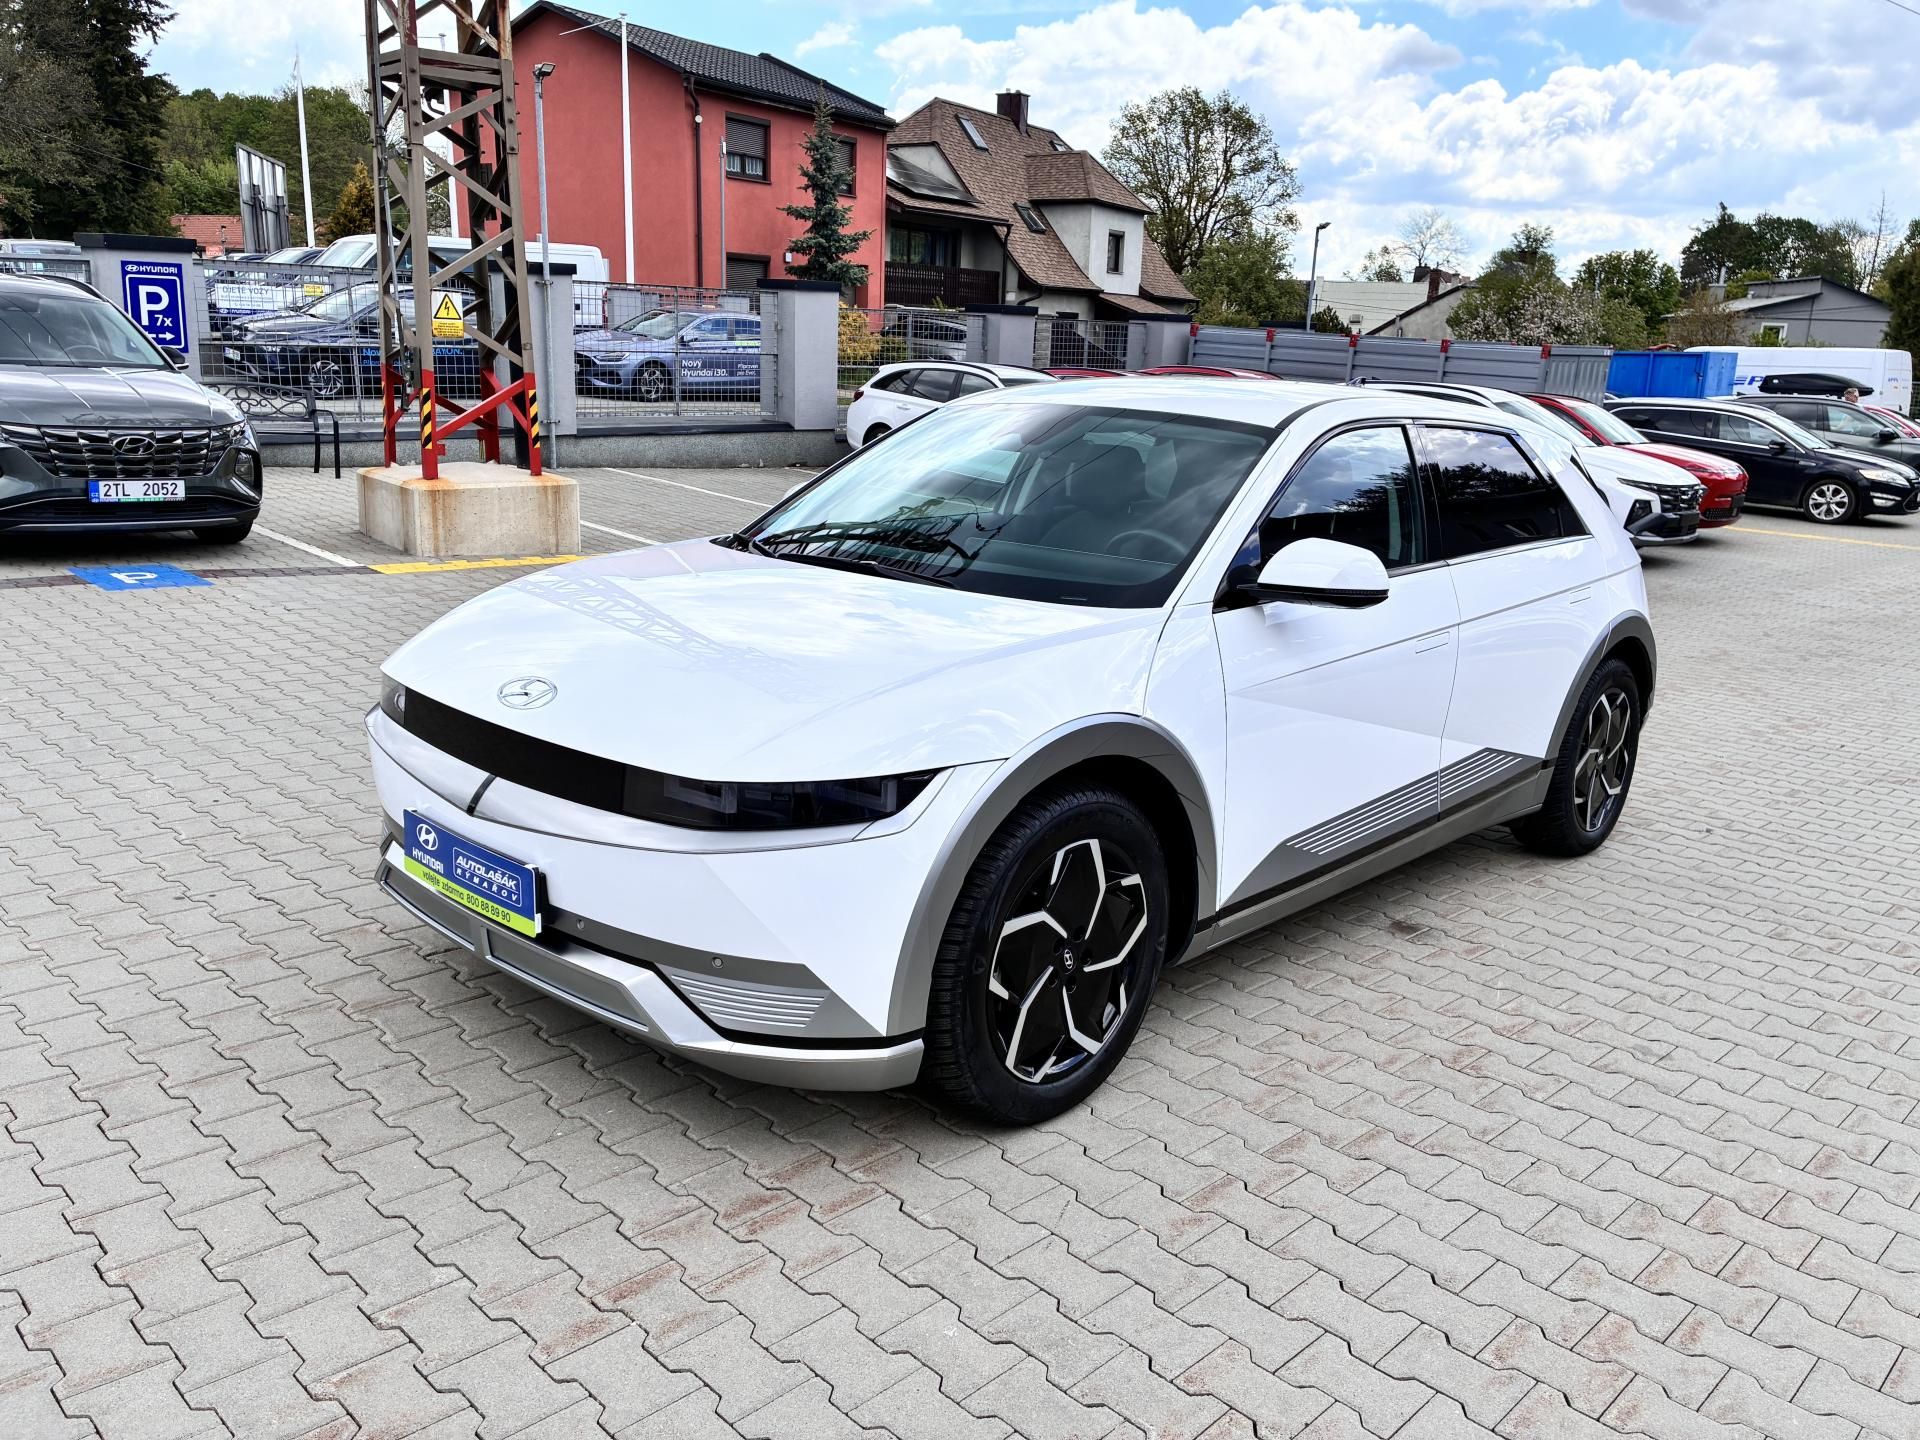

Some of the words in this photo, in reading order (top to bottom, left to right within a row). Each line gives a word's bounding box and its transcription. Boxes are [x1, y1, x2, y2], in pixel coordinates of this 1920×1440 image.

[139, 265, 178, 274] HYUNDAI
[138, 285, 170, 326] P
[154, 314, 173, 327] 7x
[681, 357, 703, 368] Nový
[681, 369, 713, 378] Hyundai
[103, 483, 131, 497] 2TL
[142, 482, 178, 496] 2052
[412, 846, 444, 874] HYUNDAI
[456, 855, 517, 891] AUTOLAŠÁK
[456, 867, 519, 901] RÝMAŘOV
[422, 870, 441, 887] volejte
[441, 880, 464, 899] zdarma
[466, 894, 480, 908] 800
[480, 900, 490, 913] 88
[490, 905, 500, 918] 89
[501, 910, 511, 923] 90
